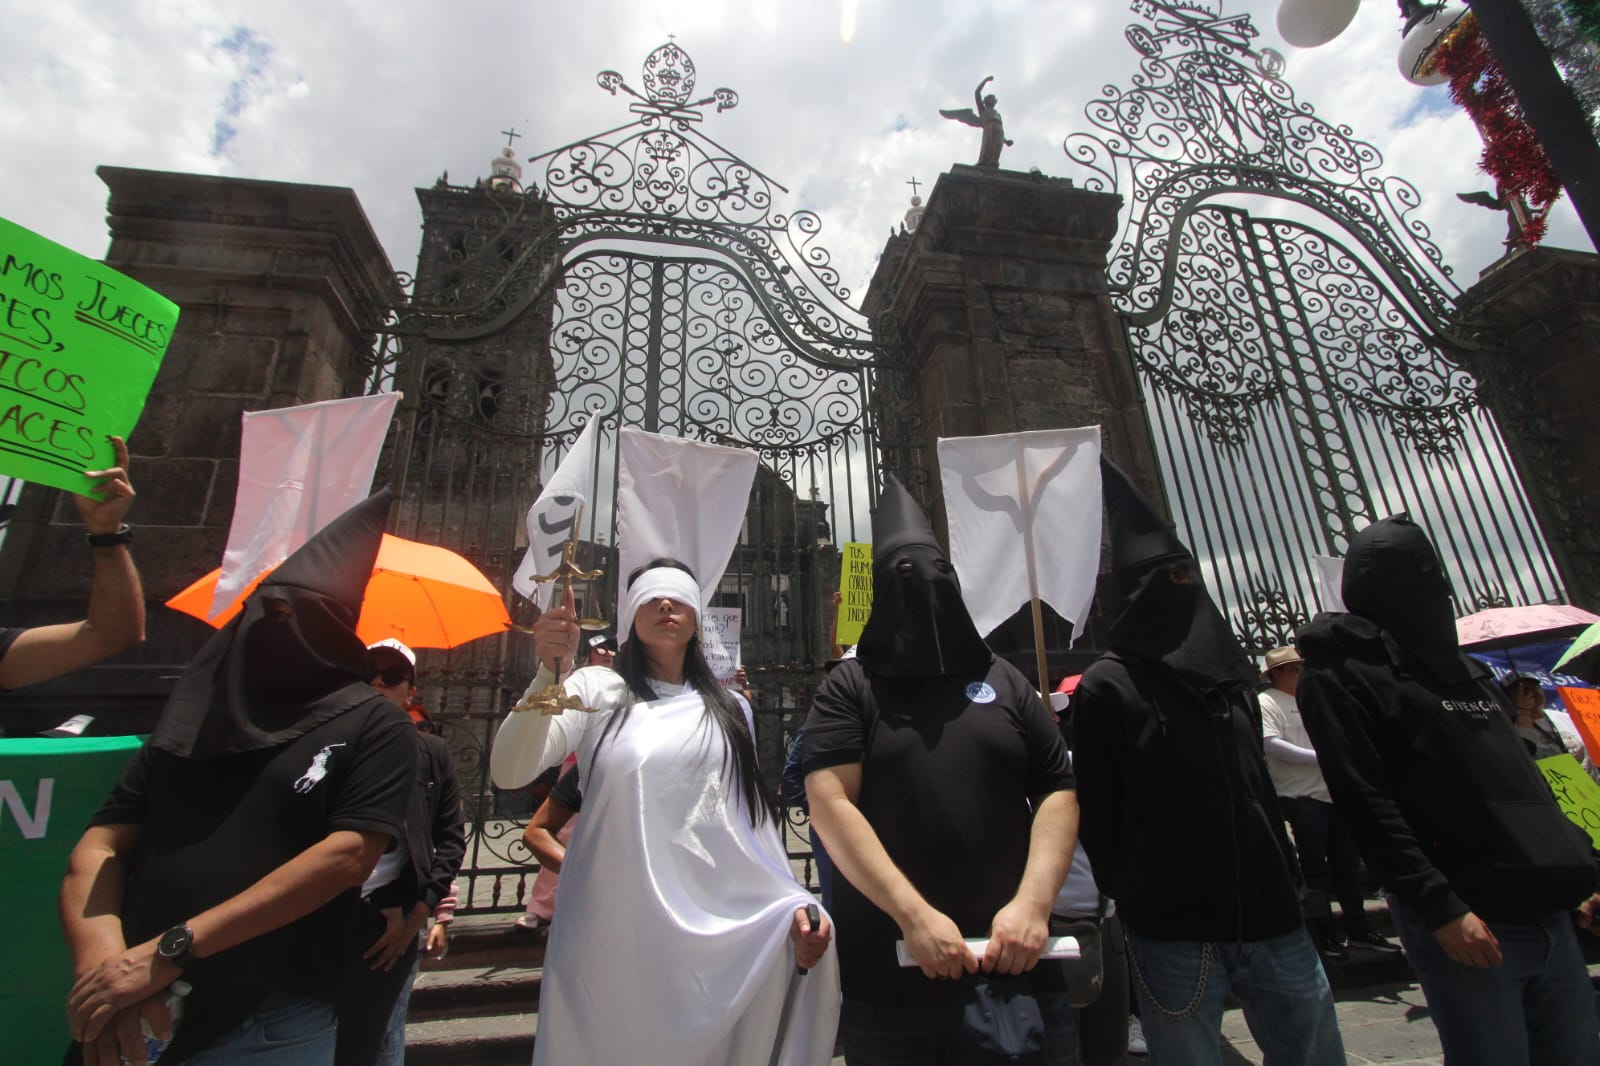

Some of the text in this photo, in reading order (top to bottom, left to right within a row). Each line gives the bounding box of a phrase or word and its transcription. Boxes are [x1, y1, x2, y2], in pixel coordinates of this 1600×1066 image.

[0, 254, 167, 349] MOS JUECES
[0, 293, 65, 353] ES,
[849, 546, 865, 559] TUS
